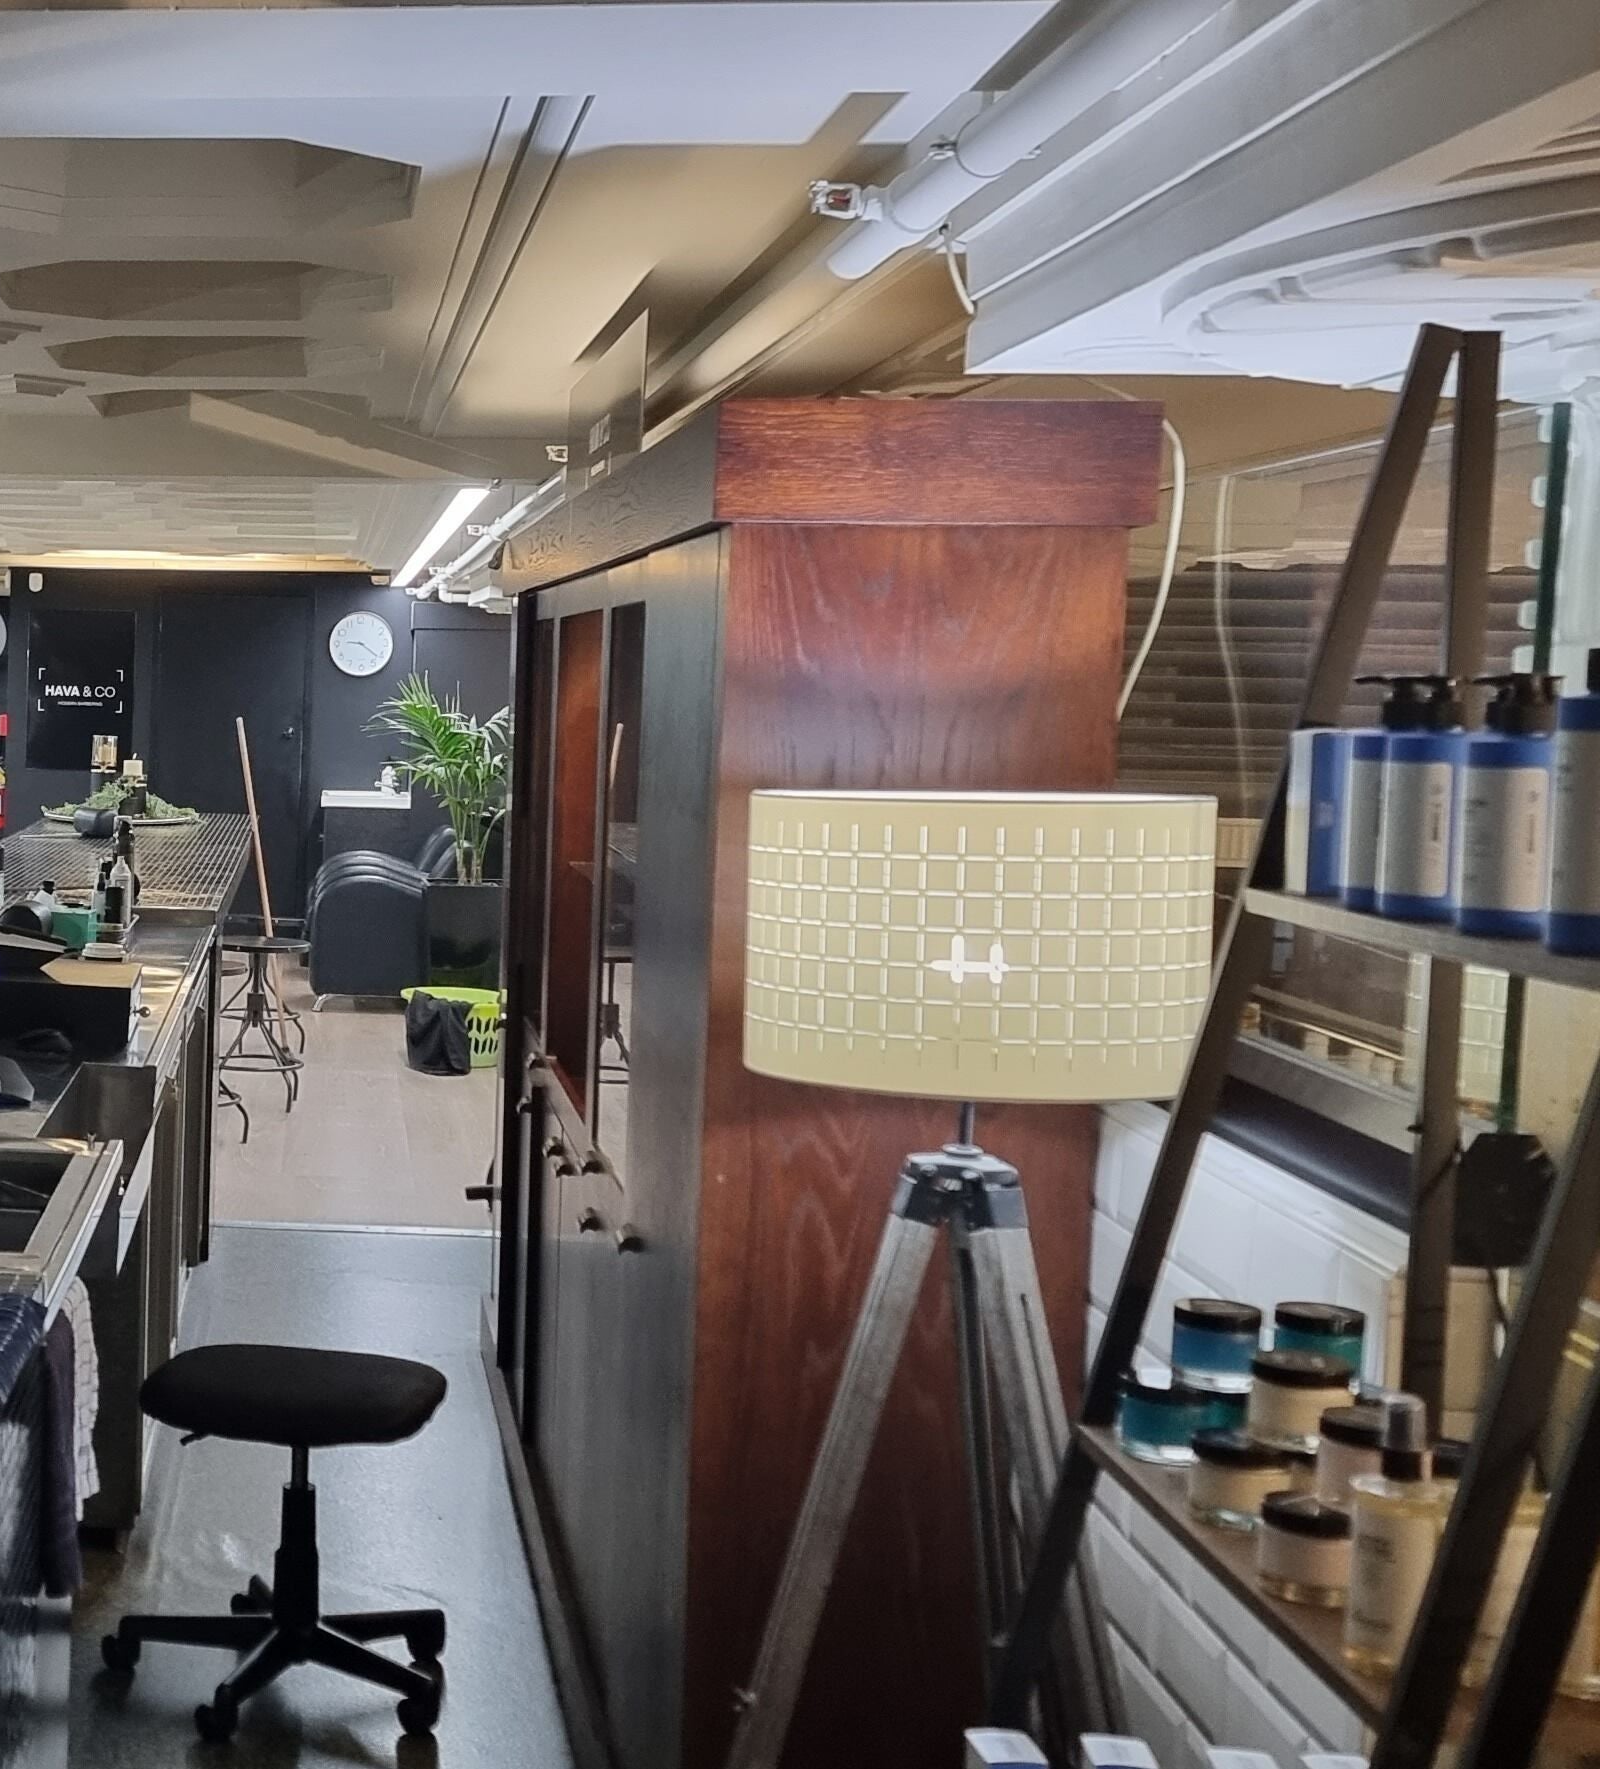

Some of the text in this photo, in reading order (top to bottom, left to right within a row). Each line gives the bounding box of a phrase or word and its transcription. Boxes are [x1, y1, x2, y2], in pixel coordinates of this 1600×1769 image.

[45, 685, 116, 698] HAVA & CO
